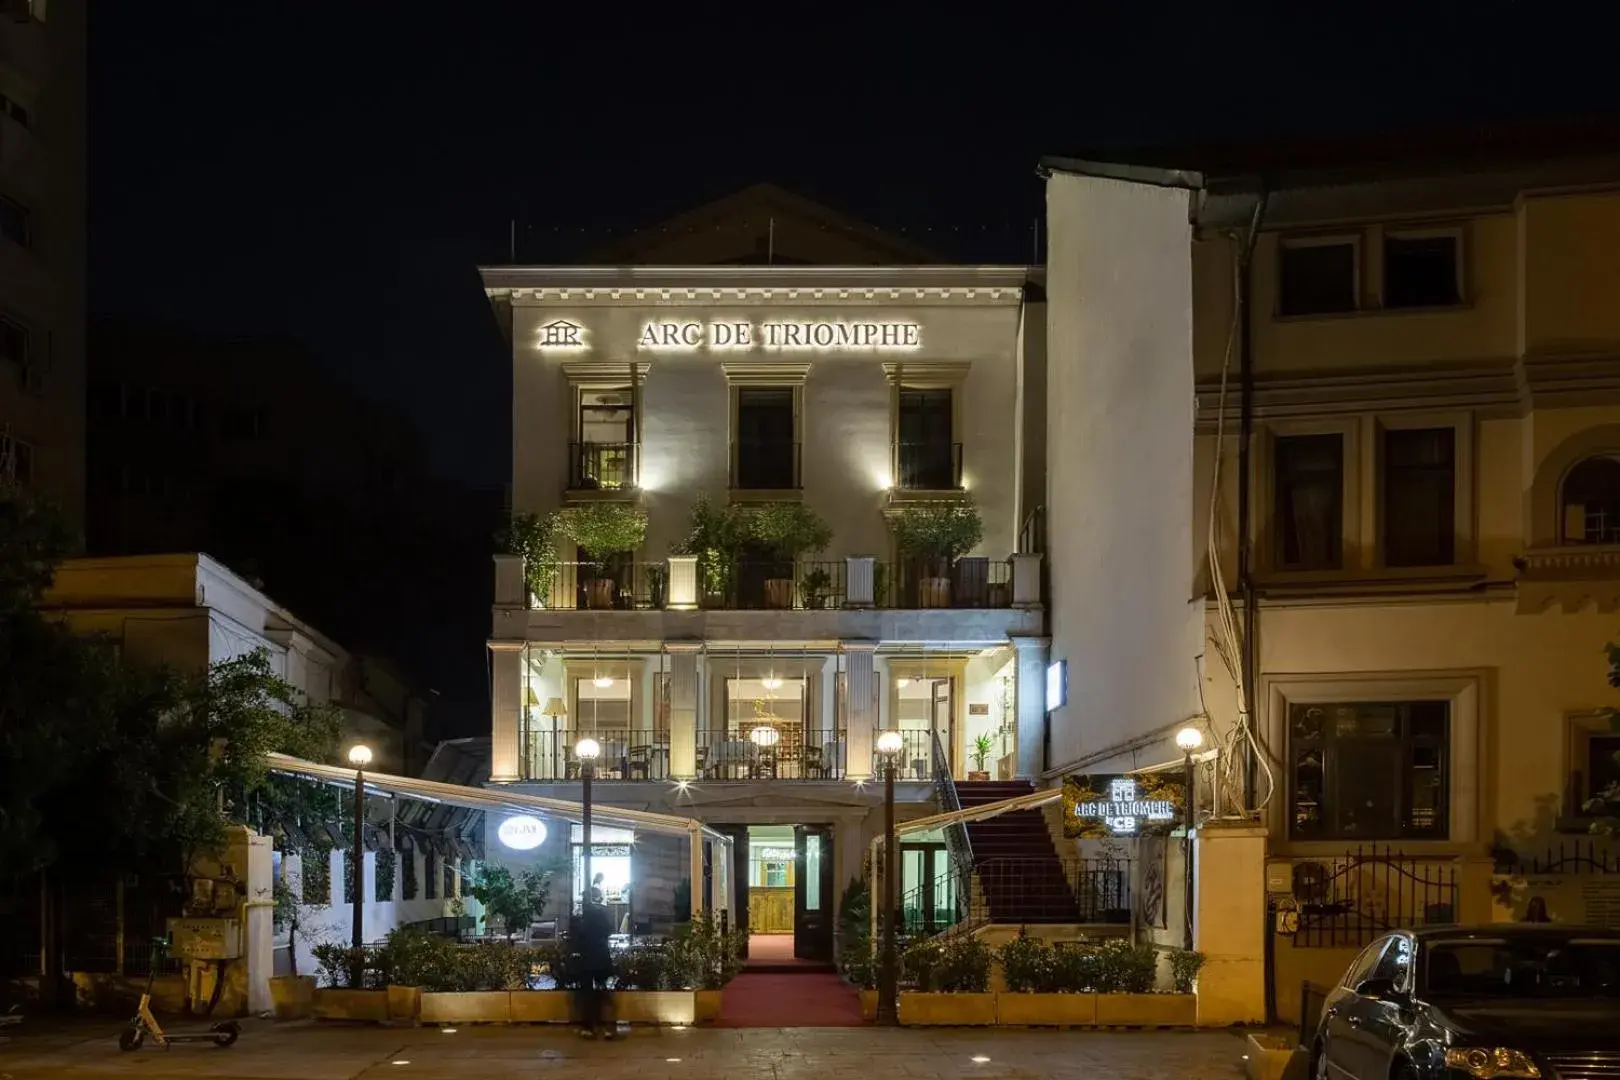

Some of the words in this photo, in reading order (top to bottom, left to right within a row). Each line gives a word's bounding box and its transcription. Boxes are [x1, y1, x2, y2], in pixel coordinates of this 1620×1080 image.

[545, 323, 580, 345] HR
[640, 323, 701, 346] ARC
[712, 323, 751, 346] DE
[764, 323, 920, 346] TRIOMPHE
[1074, 802, 1097, 816] ARC
